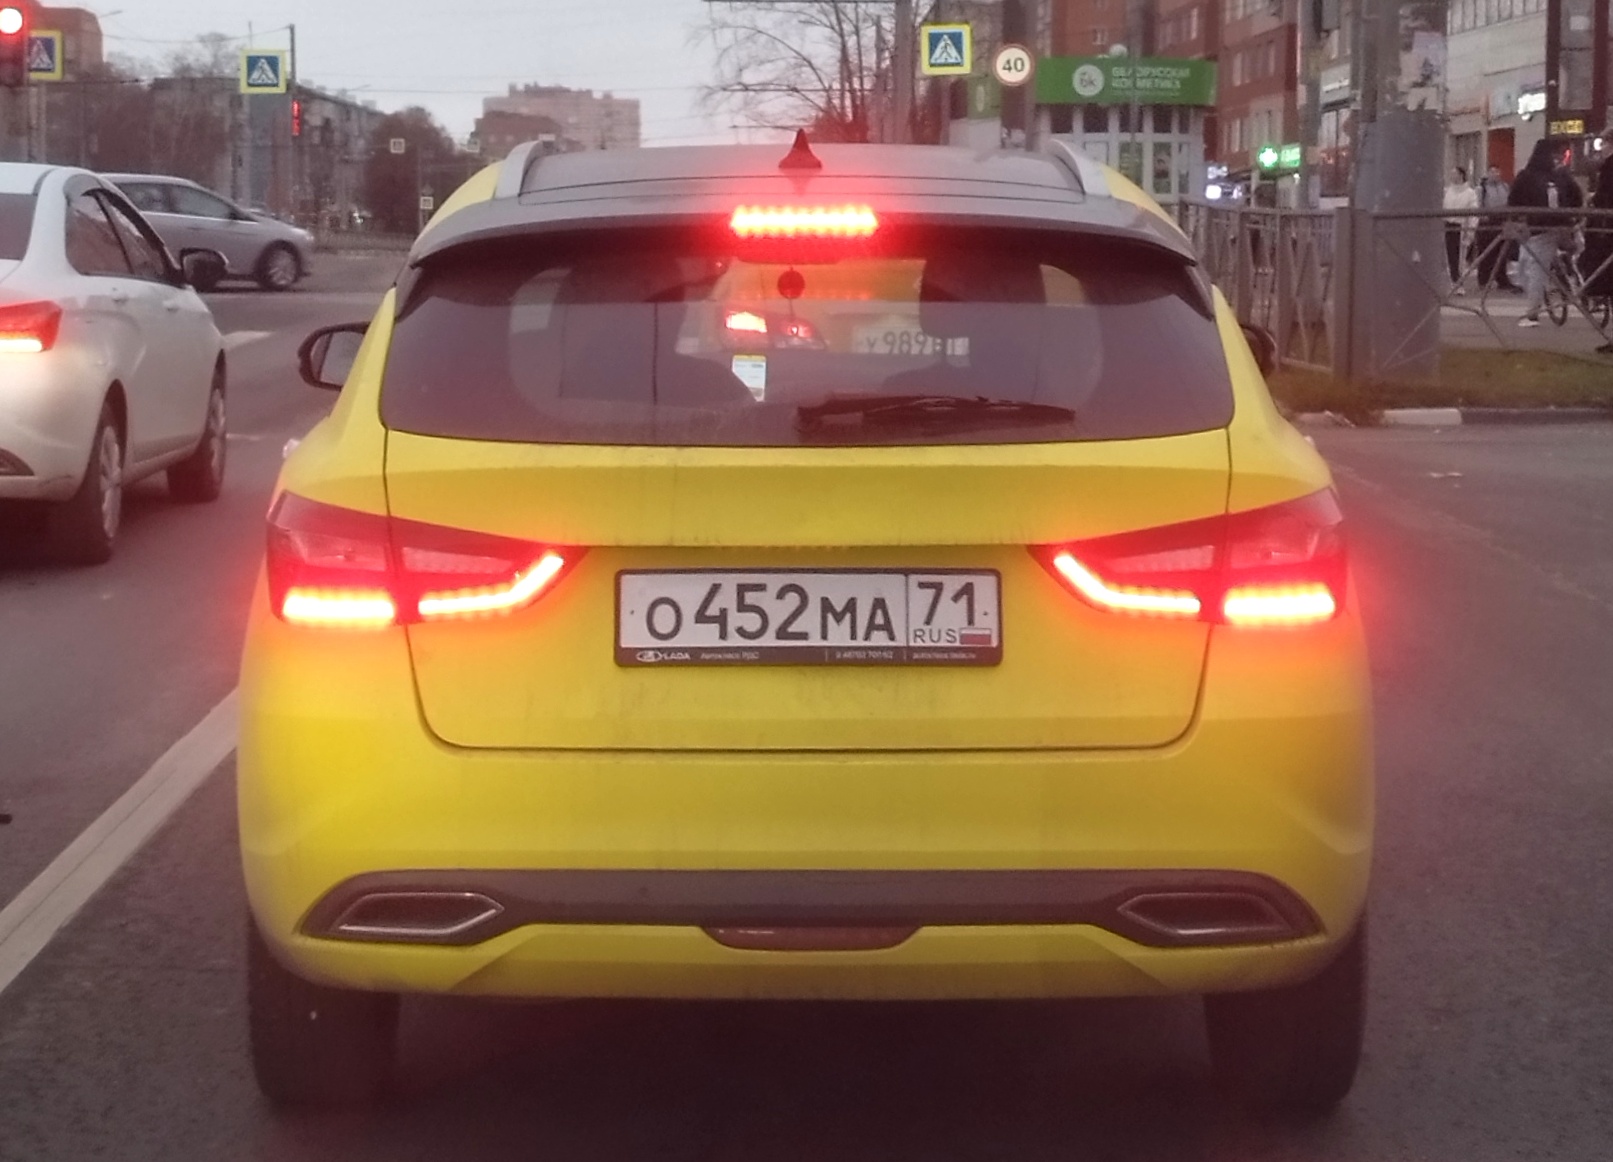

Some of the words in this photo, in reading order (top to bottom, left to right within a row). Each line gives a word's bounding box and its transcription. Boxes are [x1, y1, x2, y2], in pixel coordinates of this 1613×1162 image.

[1002, 57, 1025, 73] 40
[917, 581, 976, 627] 71
[913, 628, 957, 644] RUS
[662, 651, 691, 660] LADA
